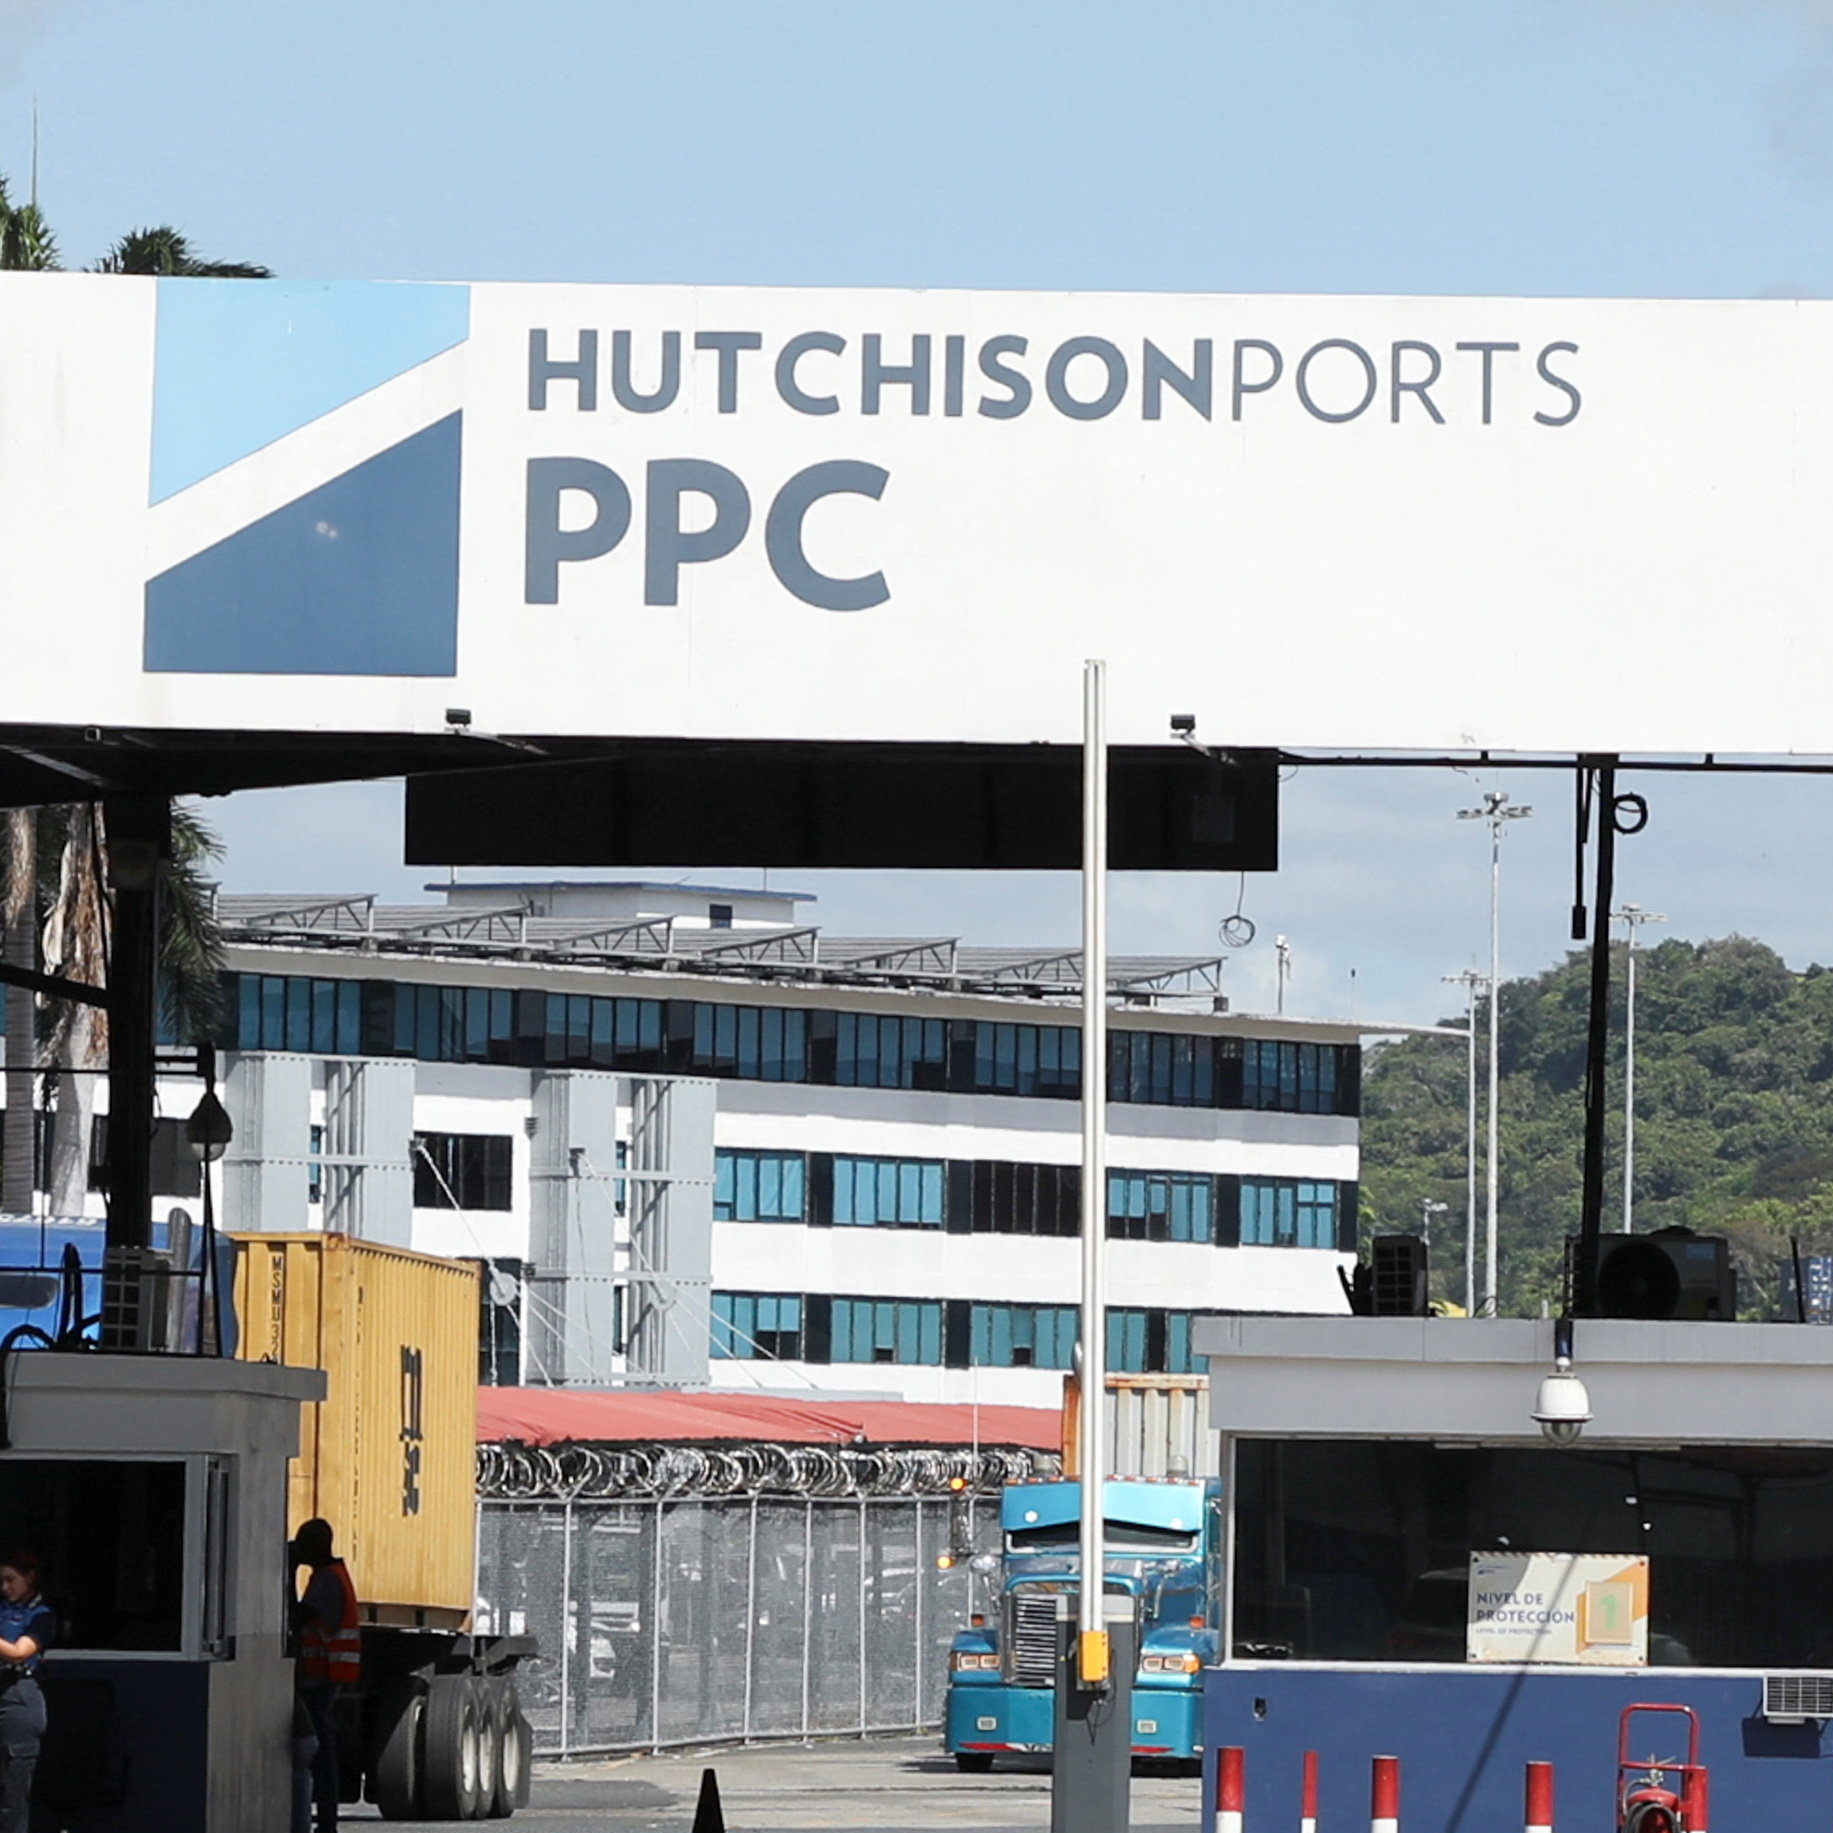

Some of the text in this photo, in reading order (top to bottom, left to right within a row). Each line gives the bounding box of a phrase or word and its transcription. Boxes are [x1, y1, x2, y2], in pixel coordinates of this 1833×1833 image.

[524, 456, 891, 612] PPC
[1477, 1592, 1544, 1605] NIVEL DE
[1600, 1594, 1617, 1630] 1
